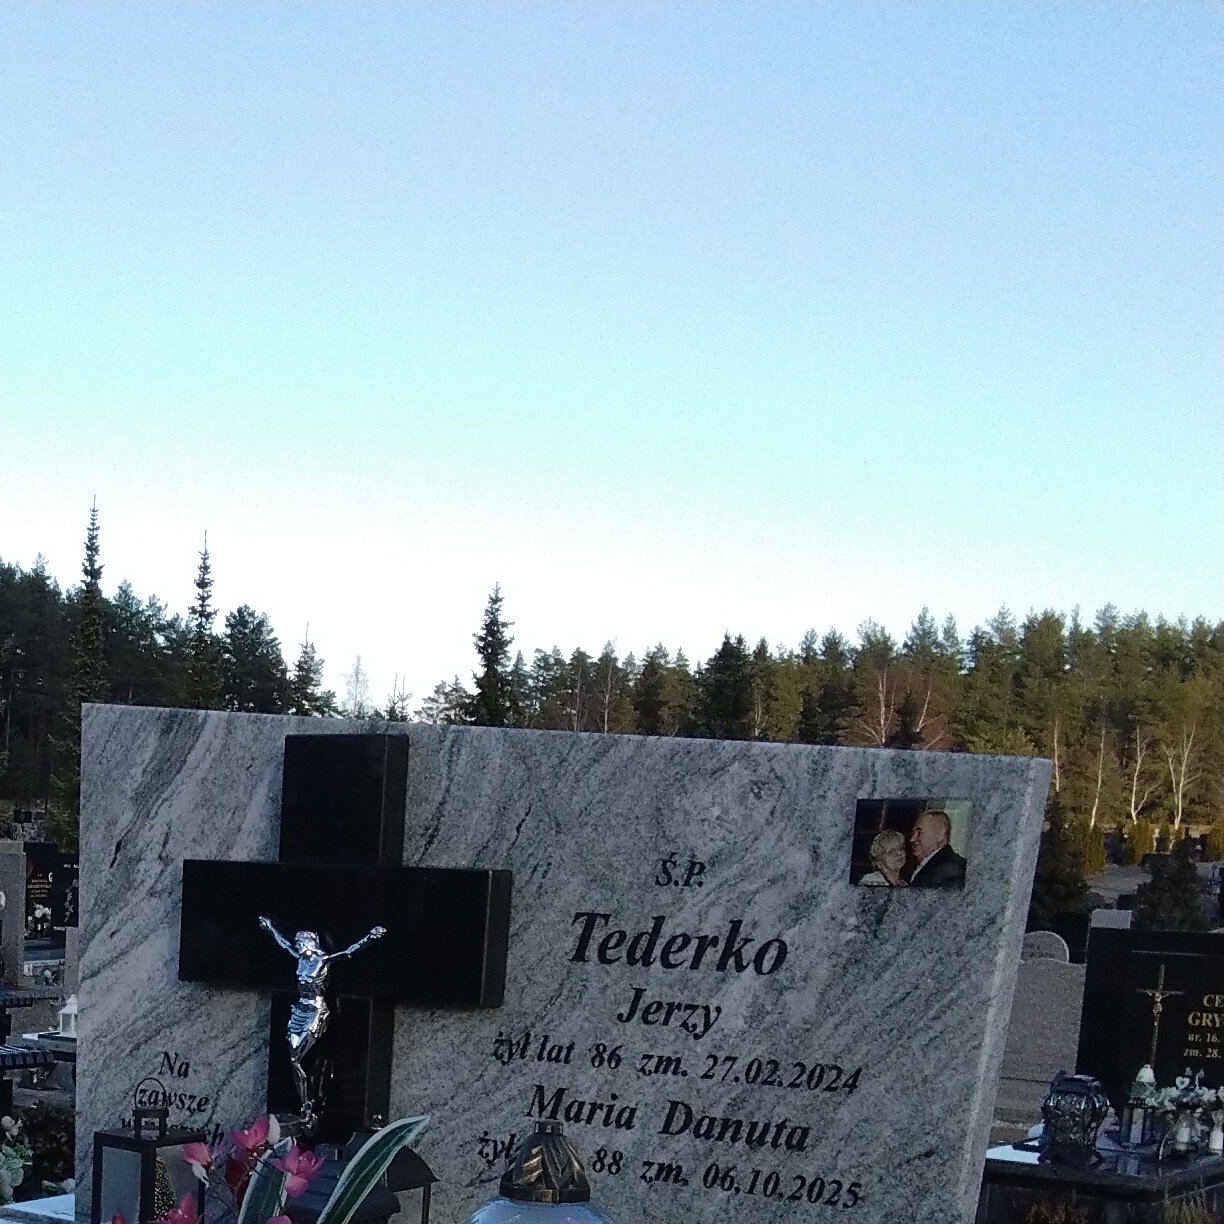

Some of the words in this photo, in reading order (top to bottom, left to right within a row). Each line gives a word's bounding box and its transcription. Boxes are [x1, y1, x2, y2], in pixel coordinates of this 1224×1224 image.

[568, 911, 789, 976] Tederko
[616, 987, 722, 1040] Jerzy
[158, 1051, 190, 1078] Na
[493, 1031, 531, 1065] żył
[537, 1035, 576, 1065] lat
[590, 1043, 622, 1071] 86
[639, 1052, 689, 1078] zm.
[700, 1054, 863, 1095] 27.02.2024
[137, 1088, 209, 1114] zawsze
[525, 1084, 638, 1131] Maria
[658, 1099, 813, 1153] Danuta
[592, 1147, 623, 1175] 88
[641, 1158, 689, 1186] zm.
[702, 1163, 863, 1209] 06.10.2025
